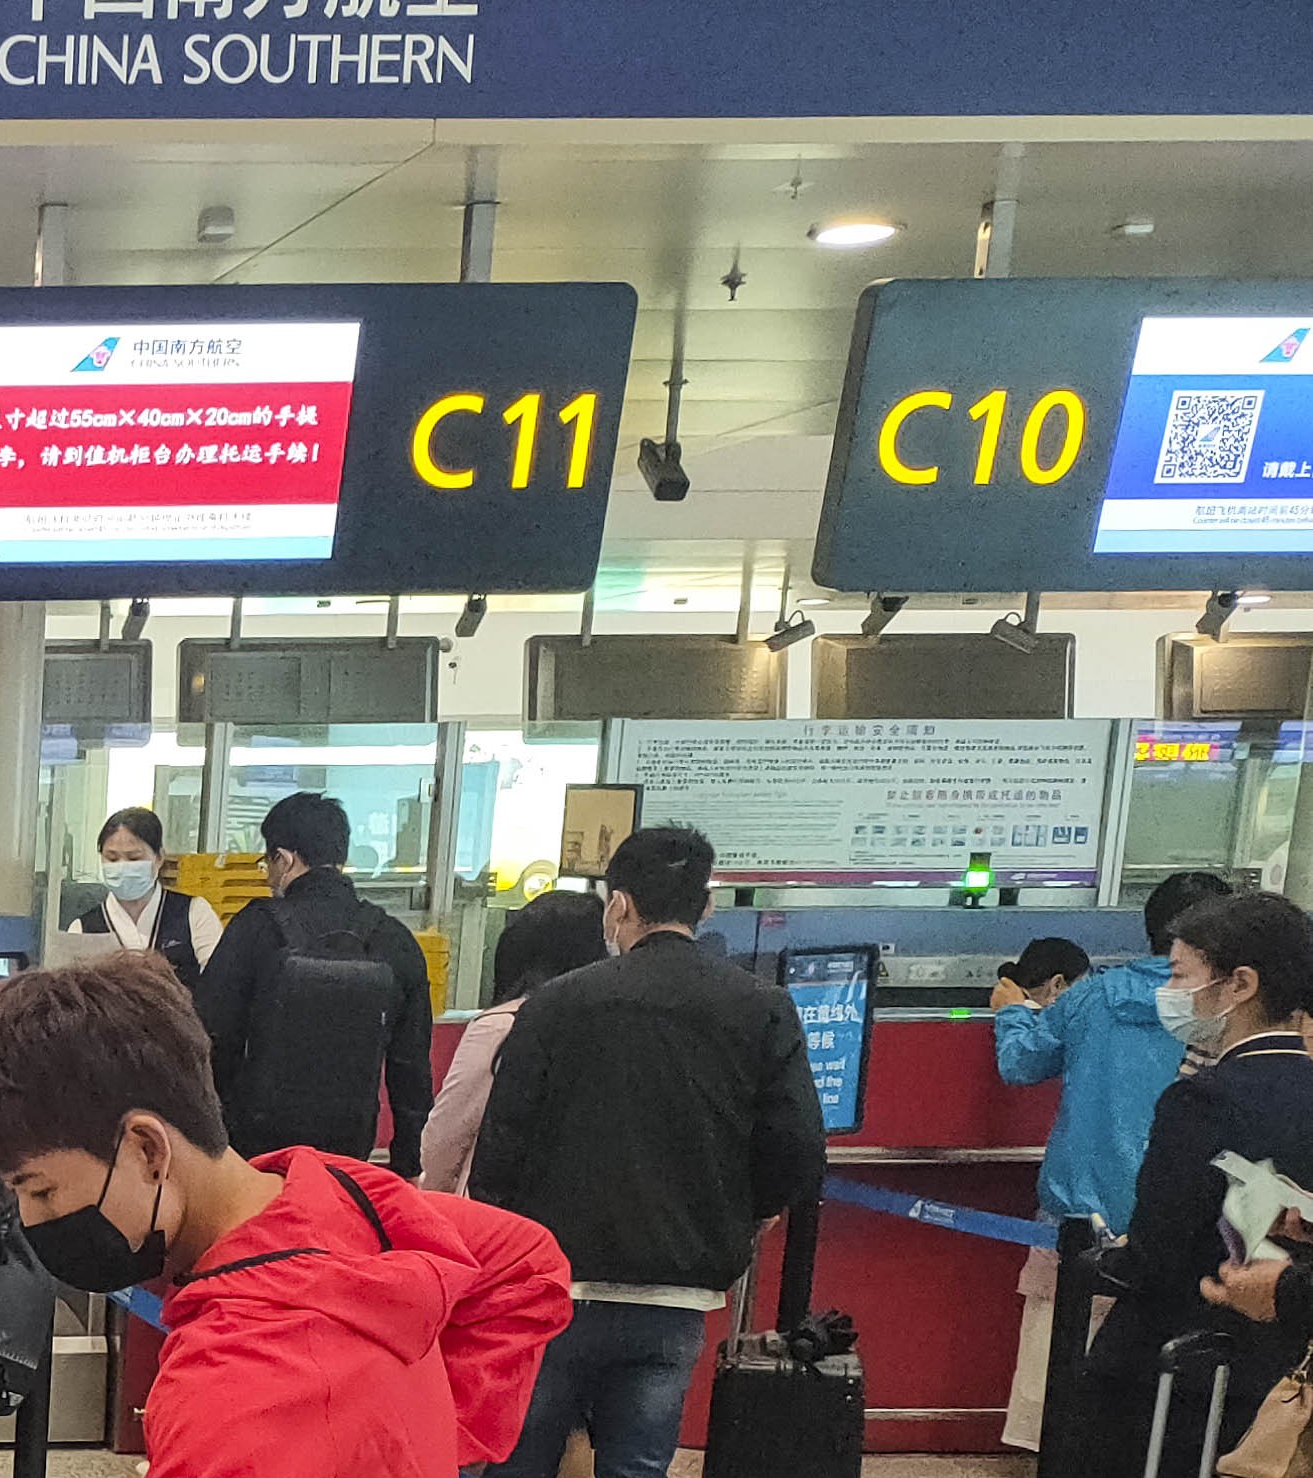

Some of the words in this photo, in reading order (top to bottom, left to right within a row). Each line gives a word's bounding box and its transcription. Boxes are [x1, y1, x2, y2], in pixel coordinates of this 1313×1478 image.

[183, 33, 474, 85] SOUTHERN
[132, 338, 243, 356] 中国南方航空
[411, 392, 599, 490] C11
[877, 389, 1087, 486] C10
[1261, 460, 1313, 479] 请戴上
